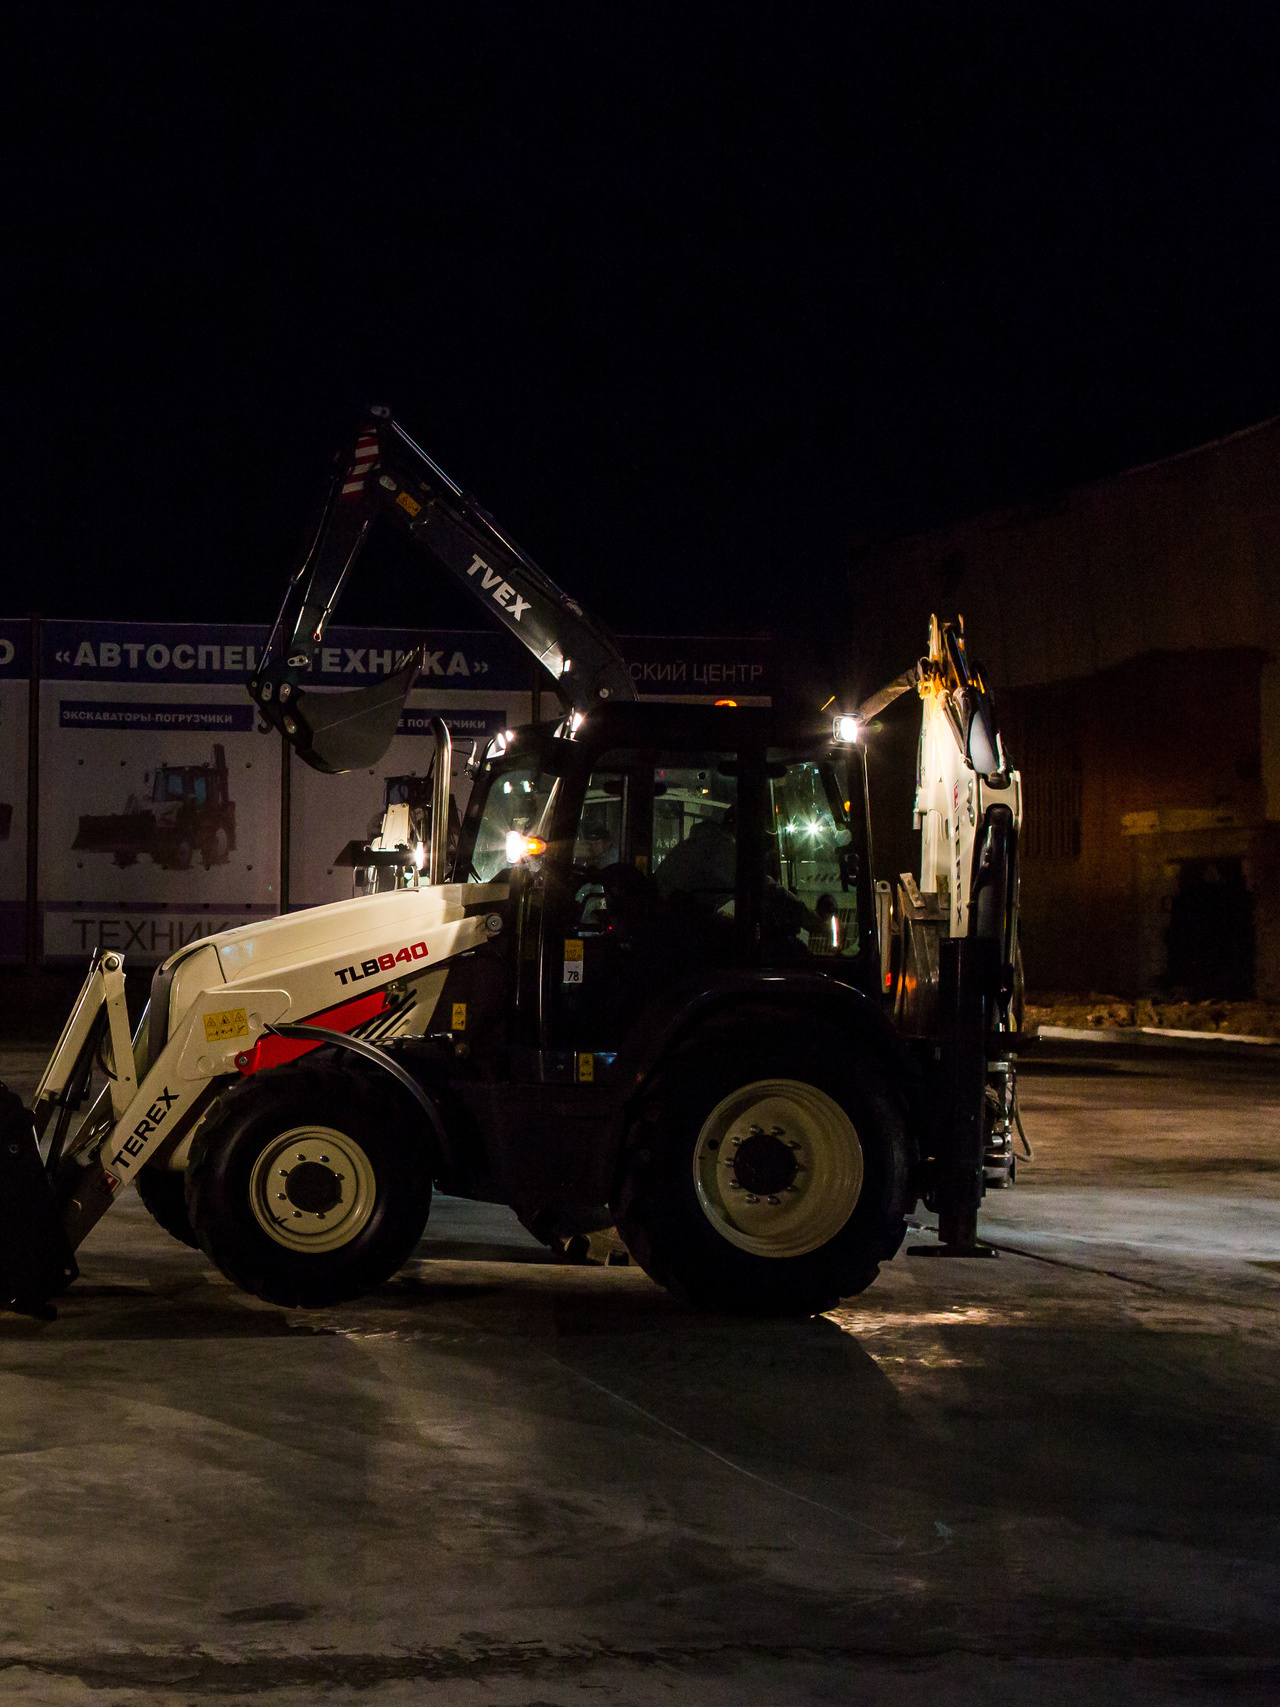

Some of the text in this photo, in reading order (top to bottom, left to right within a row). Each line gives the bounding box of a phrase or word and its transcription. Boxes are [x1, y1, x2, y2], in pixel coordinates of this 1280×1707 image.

[467, 553, 531, 622] TVEX
[692, 663, 763, 684] ЦЕНТР
[63, 710, 233, 724] ЭКСКАВАТОРЫ-ПОГРУЗЧИКИ
[407, 718, 486, 729] ПОГЗЧИКИ
[334, 941, 429, 985] TLB840
[567, 971, 579, 982] 78
[111, 1086, 180, 1168] TEREX
